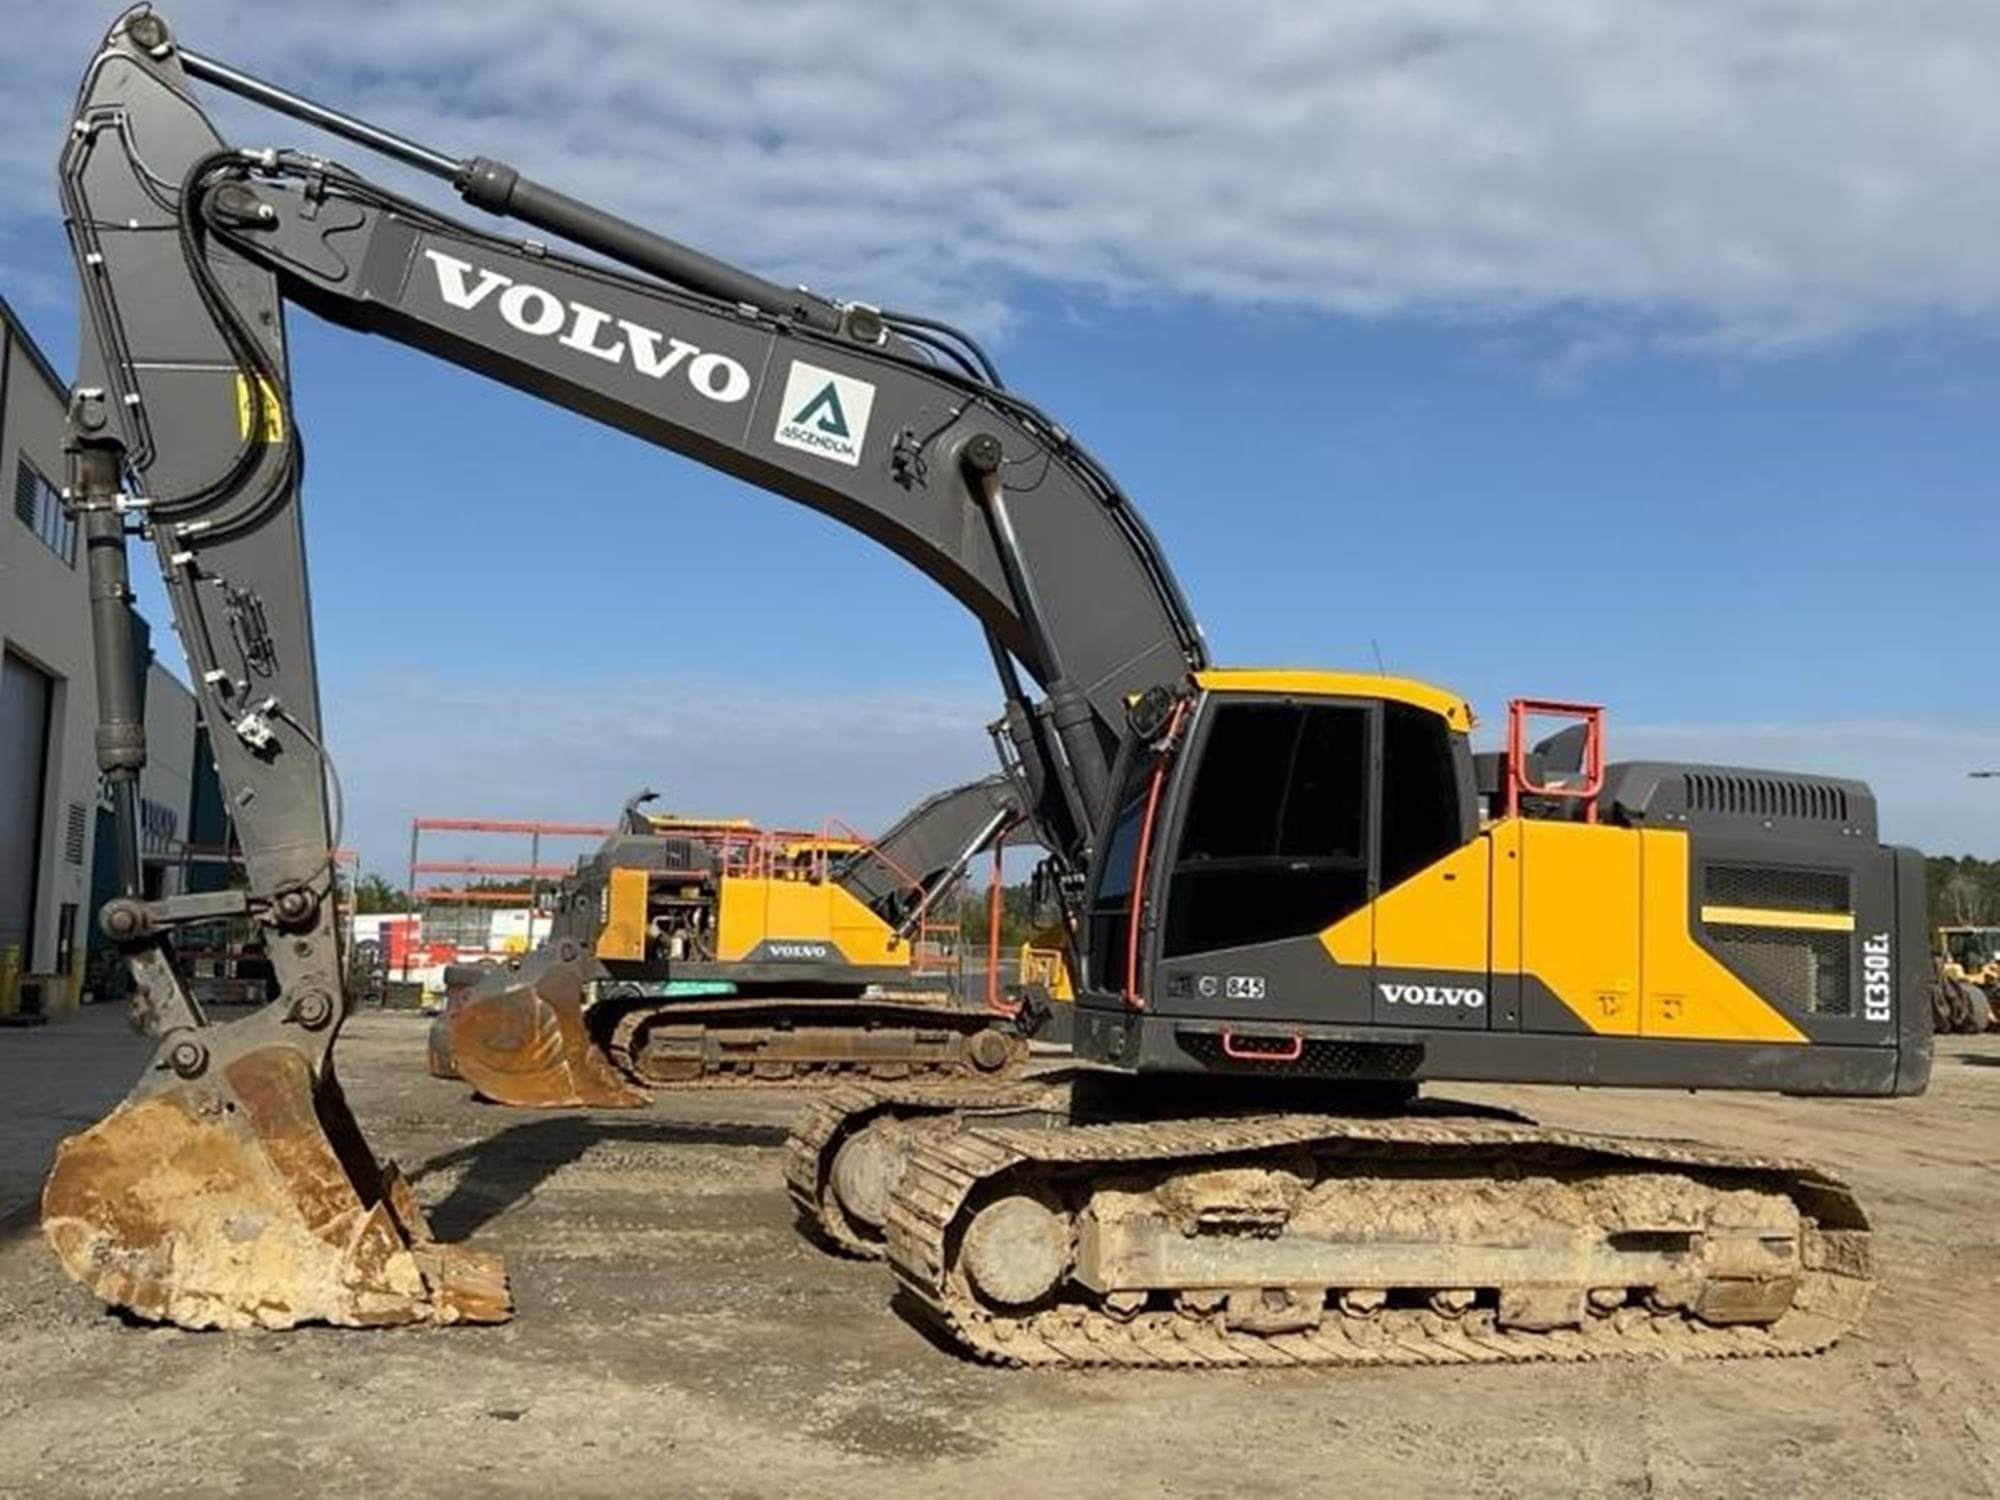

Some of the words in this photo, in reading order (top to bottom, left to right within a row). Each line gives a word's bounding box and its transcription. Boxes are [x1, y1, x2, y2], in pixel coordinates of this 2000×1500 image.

[425, 249, 750, 403] VOLVO
[781, 425, 856, 457] ASCENDUM
[769, 945, 826, 958] VOLVO
[1228, 978, 1264, 997] 845
[1379, 983, 1484, 1007] VOLVO
